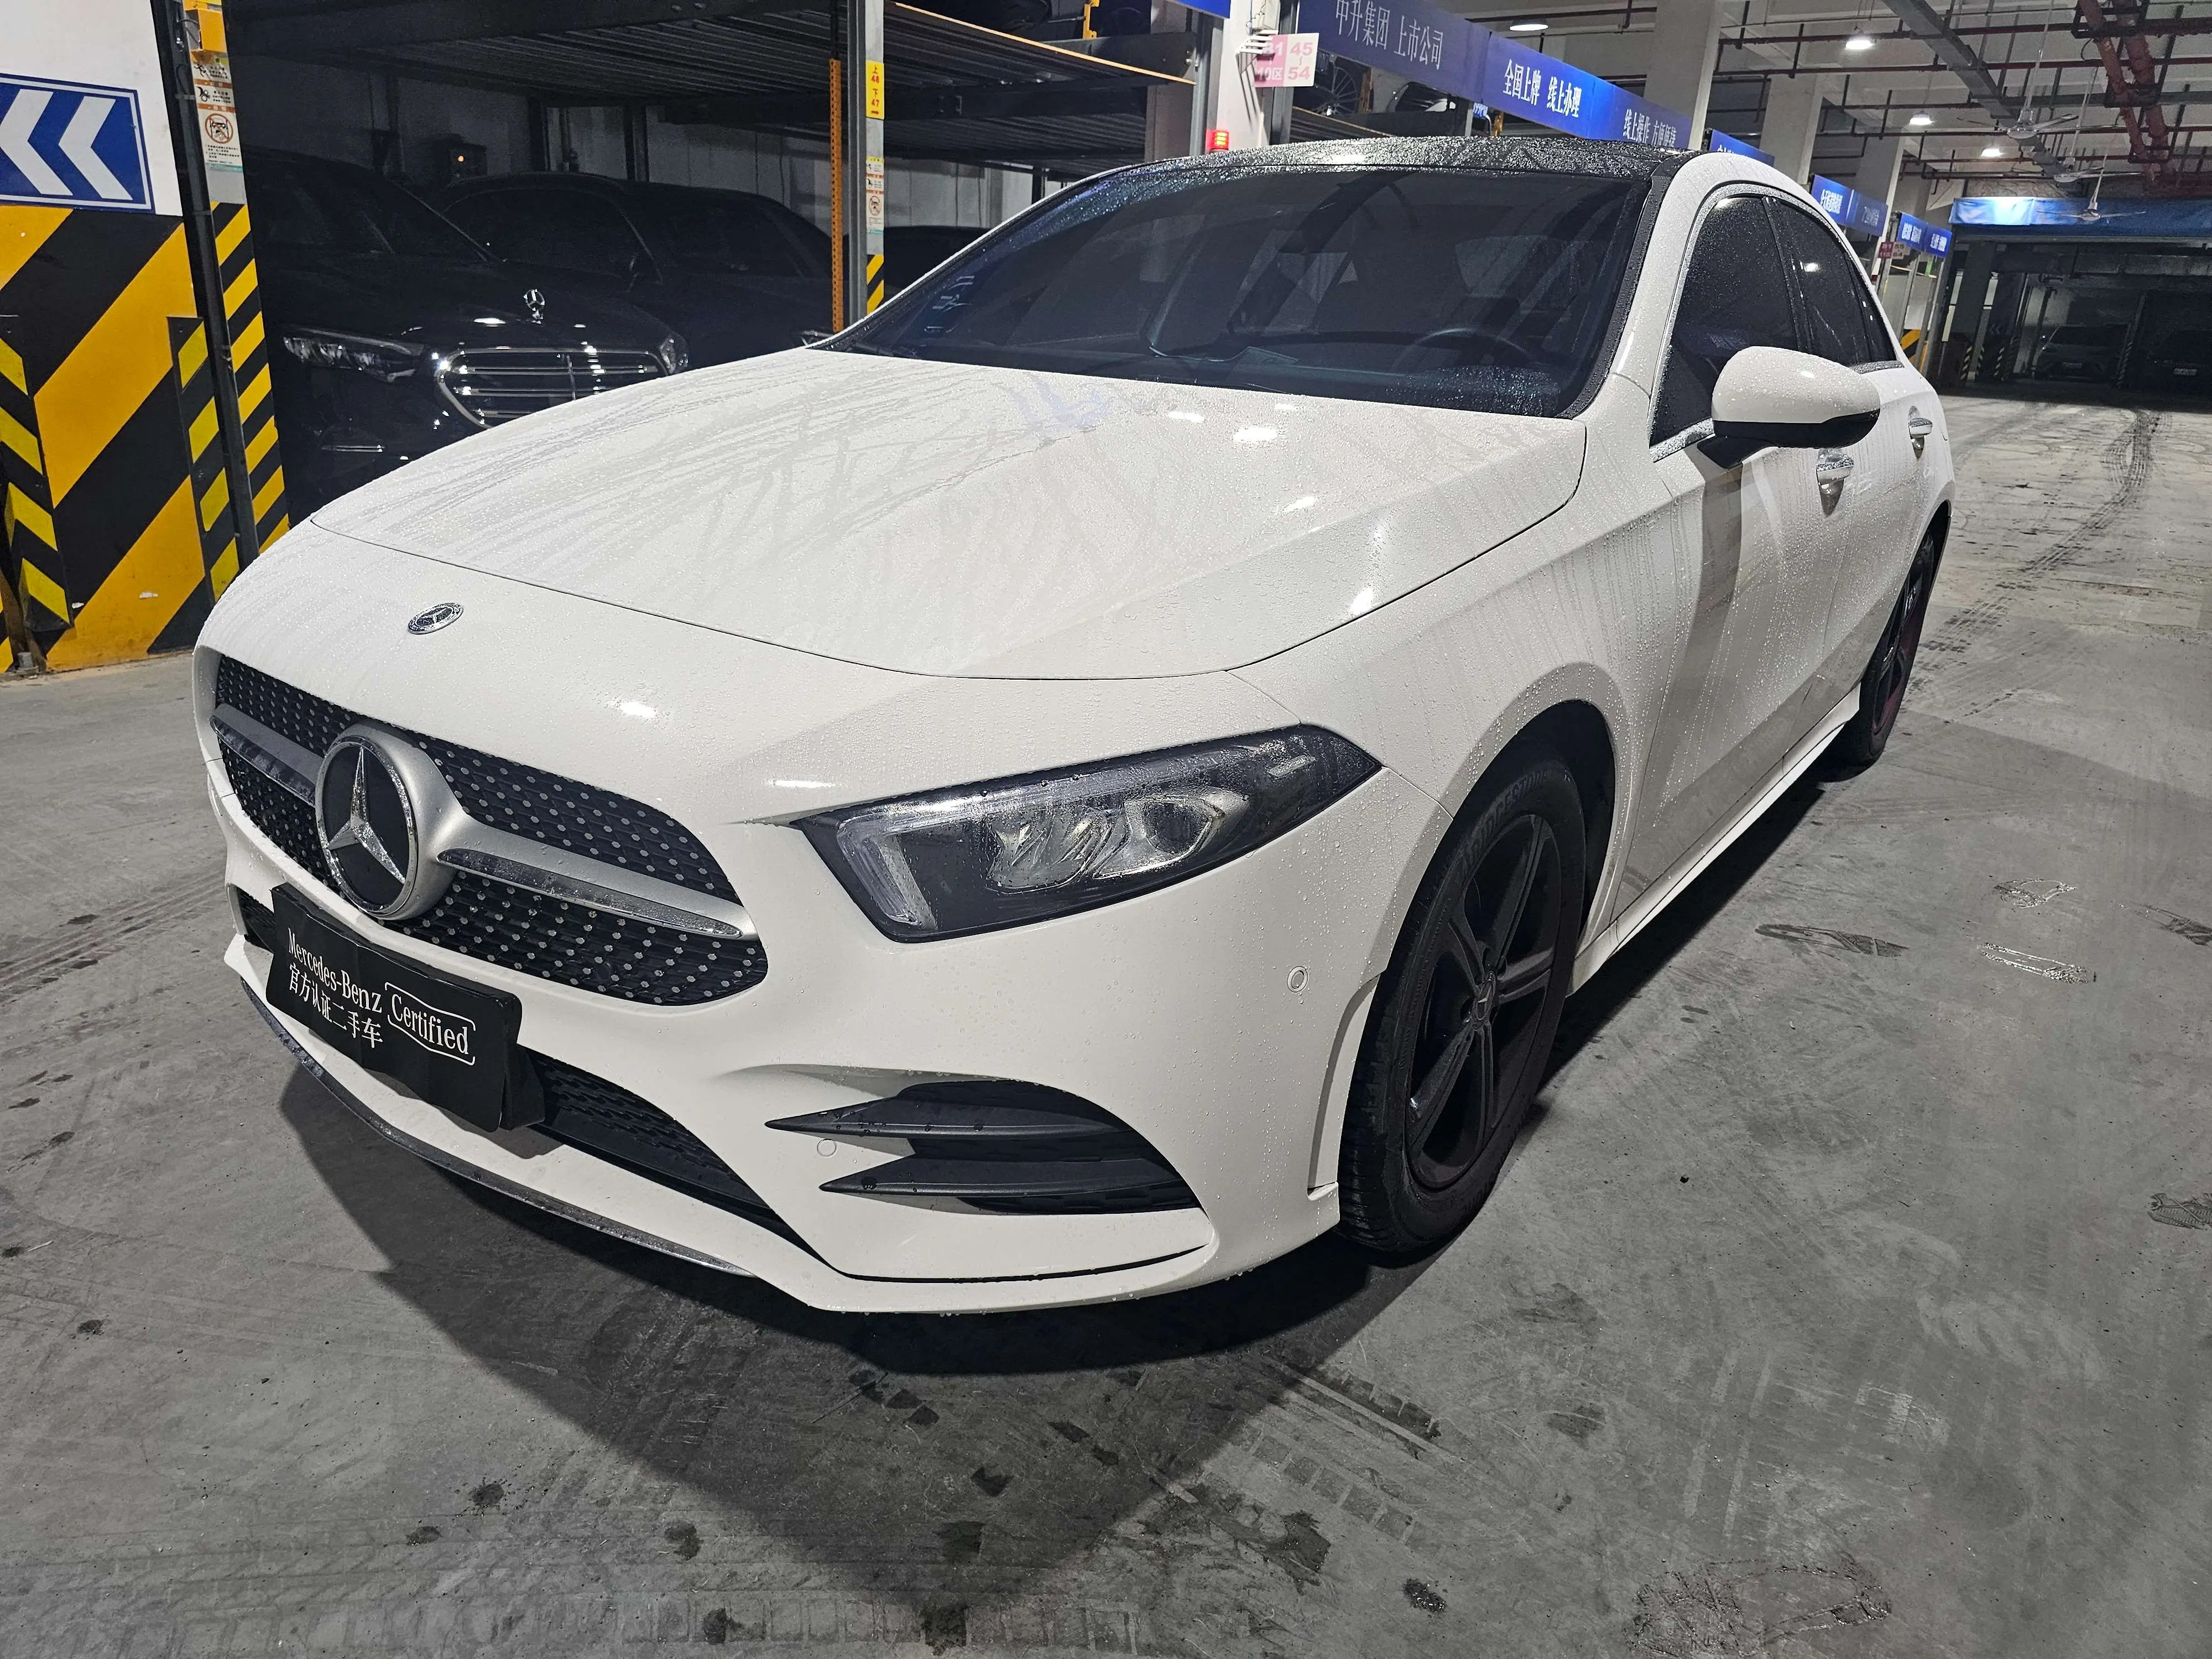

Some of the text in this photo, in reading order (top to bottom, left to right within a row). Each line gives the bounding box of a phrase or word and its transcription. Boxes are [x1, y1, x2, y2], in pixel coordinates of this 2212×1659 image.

[1290, 42, 1313, 56] 45
[1335, 0, 1443, 71] 中升集团 上市公司
[1287, 66, 1310, 80] 54
[1503, 59, 1582, 118] 全国上牌 线上办理
[288, 927, 469, 1055] Mercedes-Benz Certified
[289, 962, 383, 1048] 官方认证二手车
